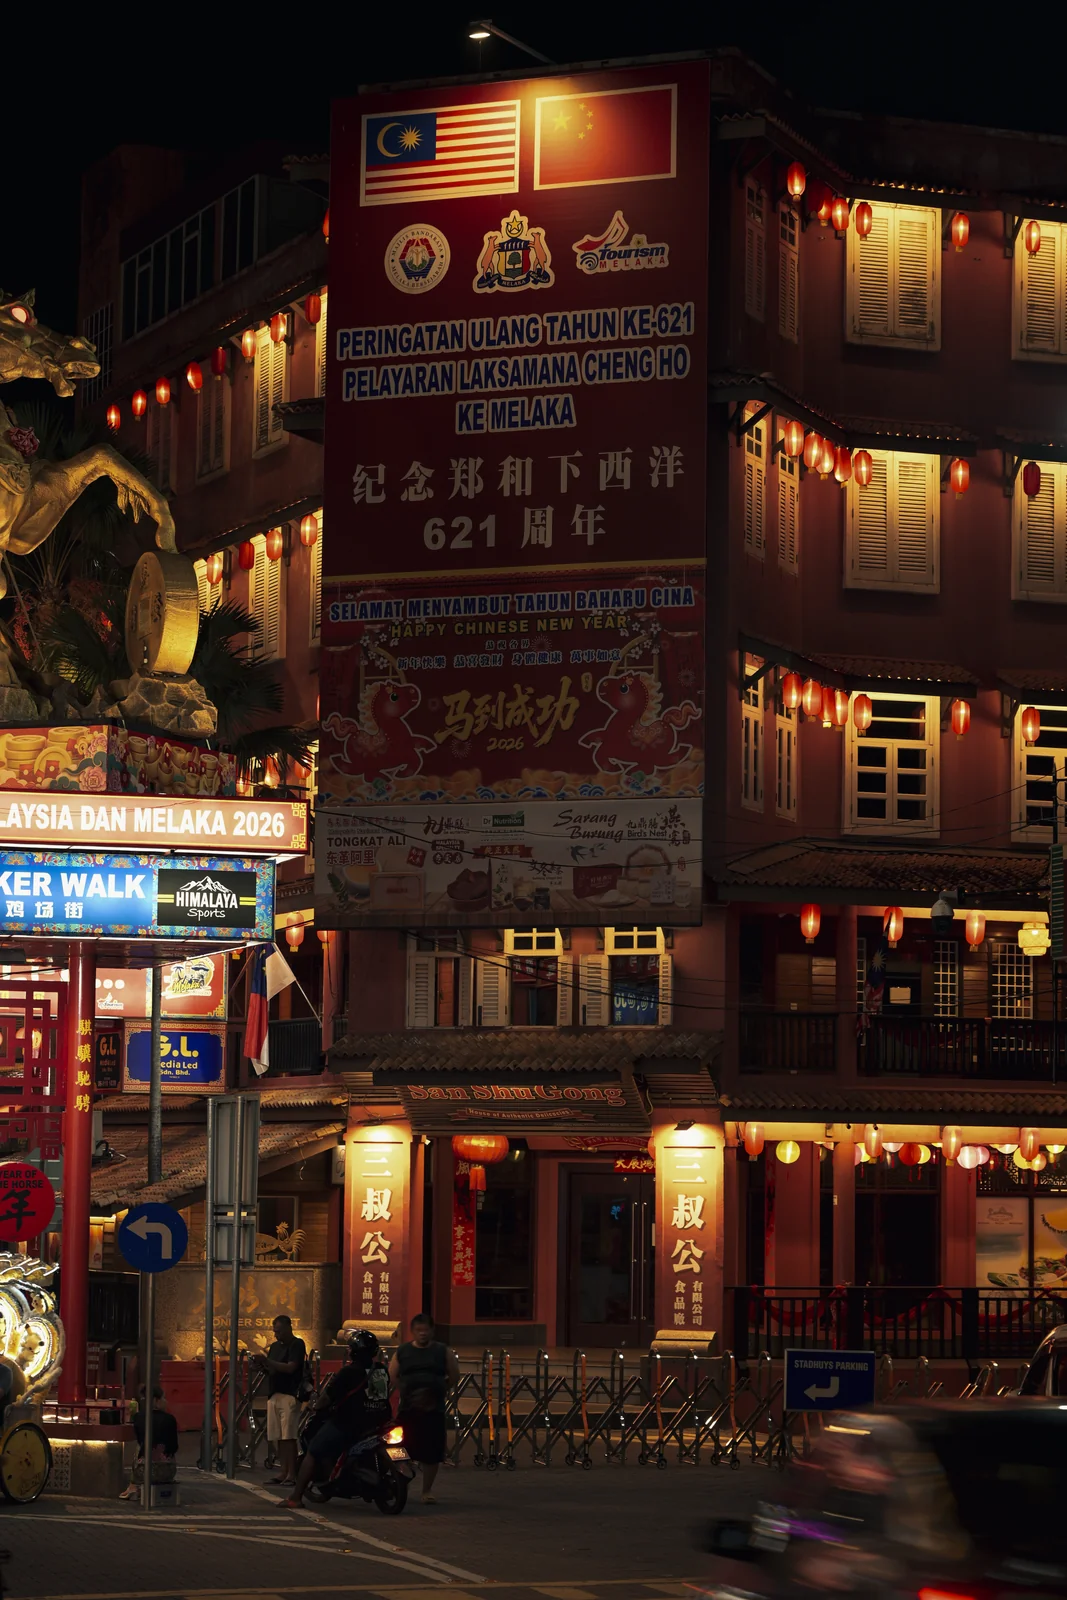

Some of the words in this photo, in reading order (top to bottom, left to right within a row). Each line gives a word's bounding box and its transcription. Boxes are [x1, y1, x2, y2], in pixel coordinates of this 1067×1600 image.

[599, 243, 666, 260] Tourism
[600, 256, 666, 268] MELAKA
[339, 322, 464, 357] PERINGATAN
[471, 314, 540, 349] ULANG
[546, 308, 615, 342] TAHUN
[624, 304, 693, 337] KE-621
[345, 364, 453, 398] PELAYARAN
[459, 355, 579, 391] LAKSAMANA
[585, 349, 652, 382] CHENG
[659, 347, 688, 377] HO
[457, 403, 485, 432] KE
[491, 397, 574, 429] MELAKA
[352, 445, 685, 505] 纪念郑和下西洋
[423, 514, 497, 550] 621
[520, 503, 607, 549] 周年
[330, 601, 404, 621] SELAMAT
[409, 595, 511, 618] MENYAMBUT
[516, 592, 570, 613] TAHUN
[577, 589, 645, 610] BAHARU
[651, 586, 694, 606] CINA
[391, 622, 447, 638] HAPPY
[454, 619, 529, 635] CHINESE
[537, 617, 574, 632] NEW
[581, 614, 629, 630] YEAR
[434, 676, 580, 747] 马到成功
[486, 736, 525, 752] 2026
[80, 805, 127, 832] DAN
[134, 806, 227, 836] MELAKA
[233, 811, 285, 837] 2026
[494, 816, 522, 825] Nutrition
[553, 809, 618, 828] Sarang
[327, 836, 384, 848] TONGKAT
[388, 834, 407, 846] ALI
[565, 825, 624, 844] Burung
[627, 830, 647, 838] Bird's
[649, 829, 667, 837] Nest
[326, 849, 376, 865] 东革阿里
[61, 872, 146, 898] WALK
[5, 900, 83, 919] 鸡场街
[176, 891, 238, 909] HIMALAYA
[187, 907, 226, 921] Sports
[161, 1060, 181, 1069] edia
[183, 1061, 198, 1069] Led
[471, 1085, 535, 1100] Shu
[535, 1085, 626, 1107] Gong
[468, 1108, 491, 1117] House
[502, 1112, 534, 1120] Authentic
[535, 1109, 570, 1119] Delicacies
[25, 1170, 37, 1178] OF
[12, 1180, 44, 1189] HORSE
[360, 1147, 393, 1265] 三叔公
[671, 1151, 707, 1274] 三叔公
[379, 1270, 390, 1316] 有限公司
[692, 1279, 704, 1326] 有限公司
[794, 1360, 834, 1370] STADHUYS
[835, 1361, 869, 1372] PARKING
